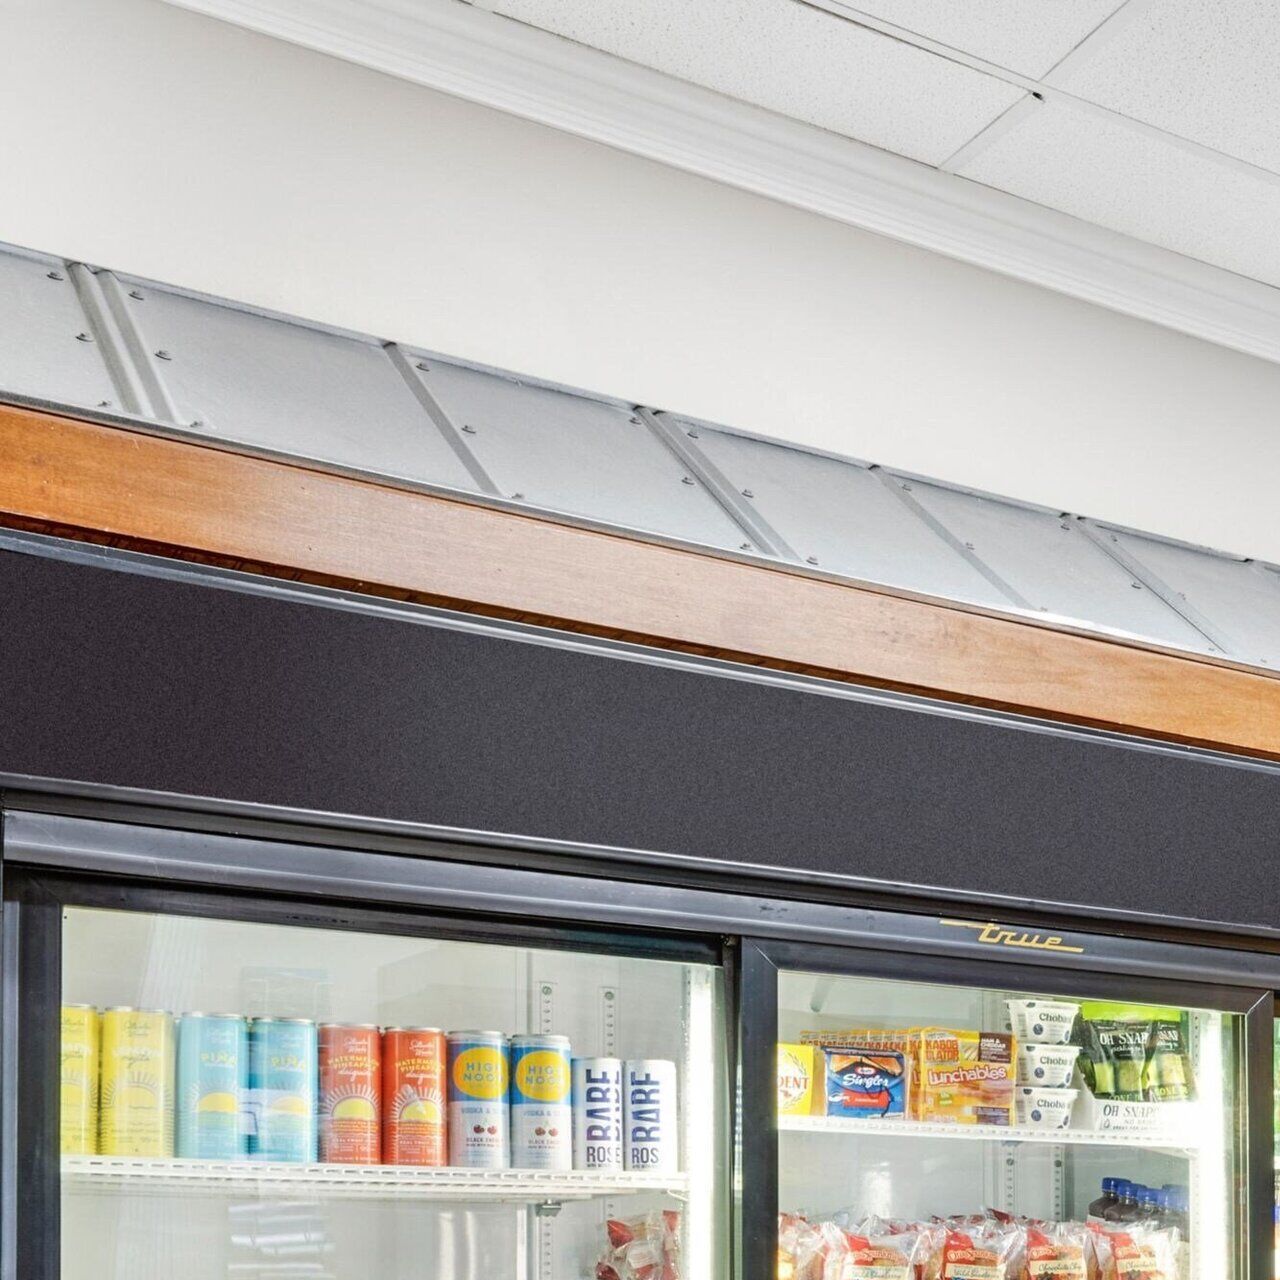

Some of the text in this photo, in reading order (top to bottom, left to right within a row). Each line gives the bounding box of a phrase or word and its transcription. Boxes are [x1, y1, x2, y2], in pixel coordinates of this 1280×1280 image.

[1100, 1031, 1113, 1045] OH
[842, 1072, 888, 1089] Singles
[928, 1066, 1007, 1086] Lunchables
[1103, 1105, 1119, 1118] OH
